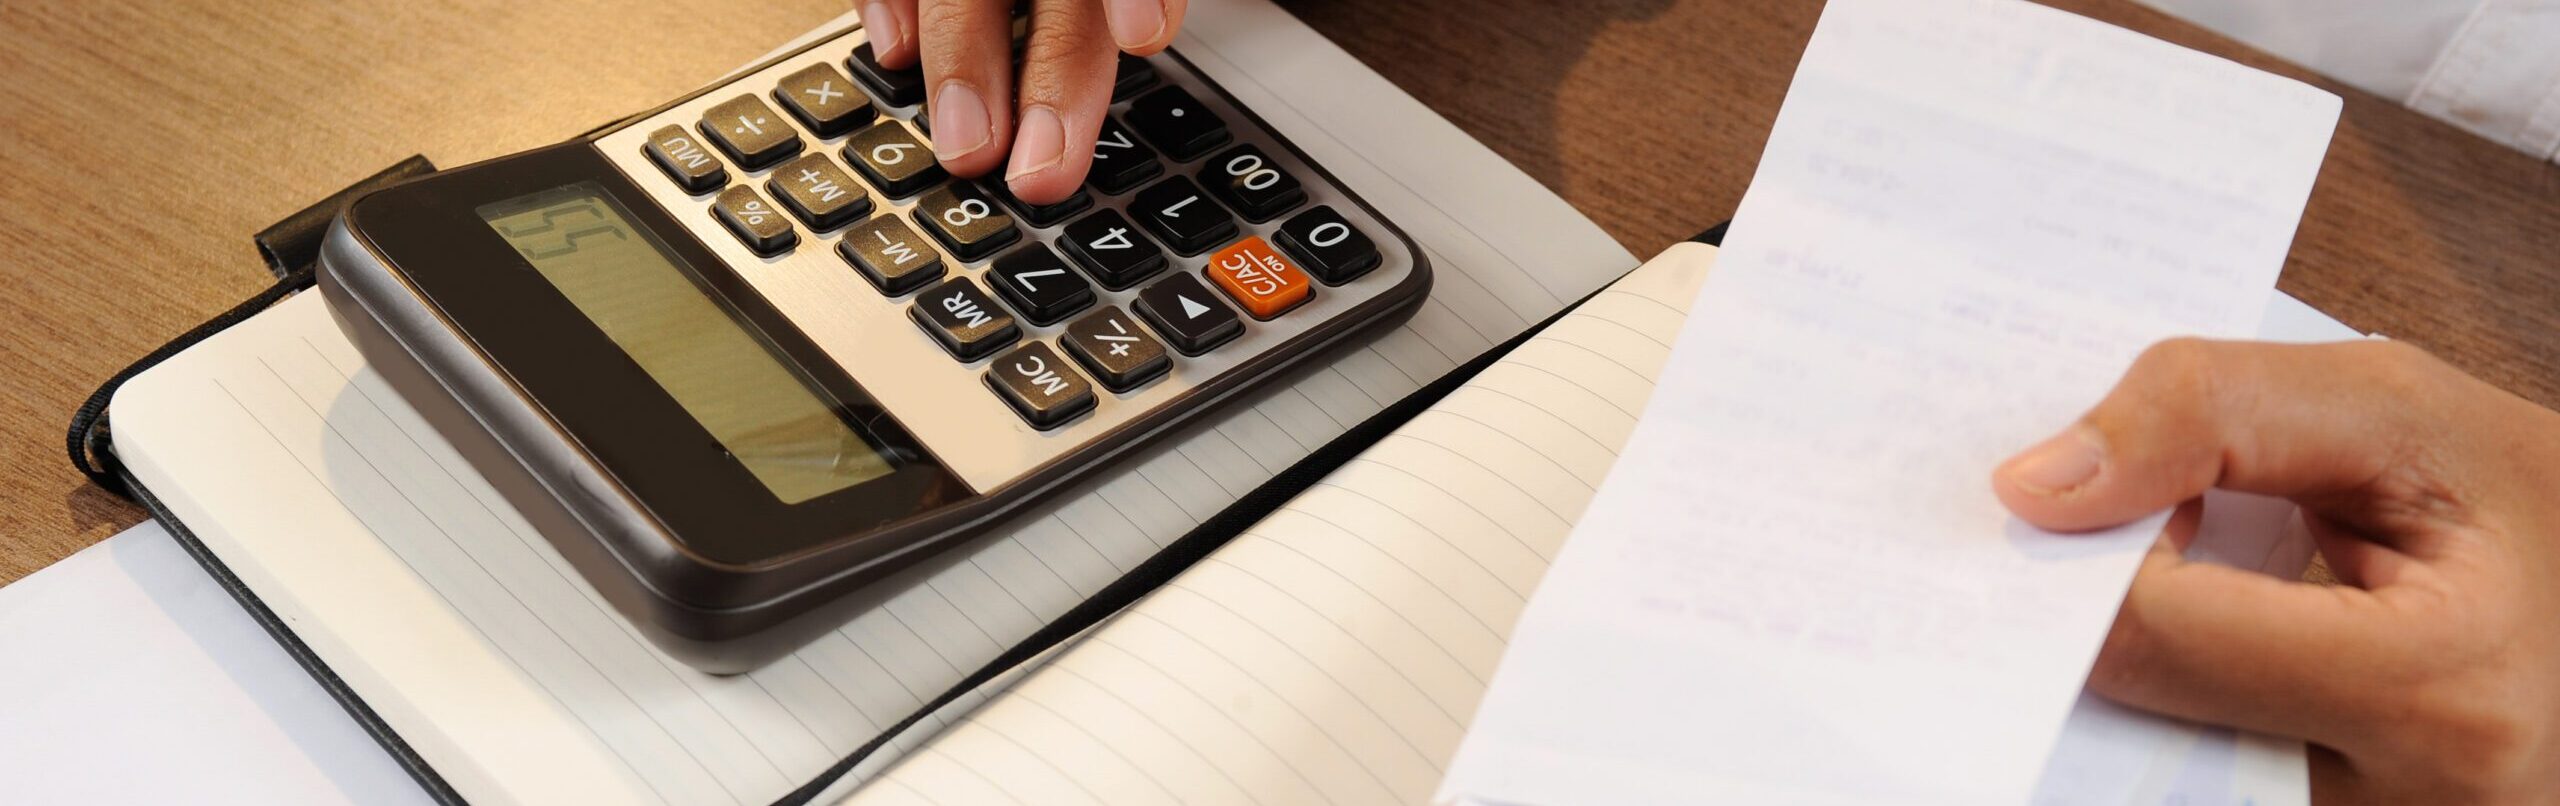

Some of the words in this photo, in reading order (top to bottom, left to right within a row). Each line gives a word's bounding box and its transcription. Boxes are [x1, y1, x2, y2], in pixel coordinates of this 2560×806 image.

[662, 137, 711, 170] MU
[872, 143, 917, 165] 9
[1093, 131, 1135, 159] 2
[799, 168, 847, 202] M+
[1226, 154, 1281, 190] 00
[738, 201, 772, 225] %
[944, 199, 990, 226] 8
[1161, 195, 1199, 218] 1
[1089, 227, 1134, 250] 4
[1309, 222, 1350, 247] 0
[1221, 253, 1277, 296] C/AC
[1263, 255, 1286, 273] ON
[1014, 269, 1066, 292] 7
[943, 291, 992, 329] MR
[1015, 356, 1069, 396] MC
